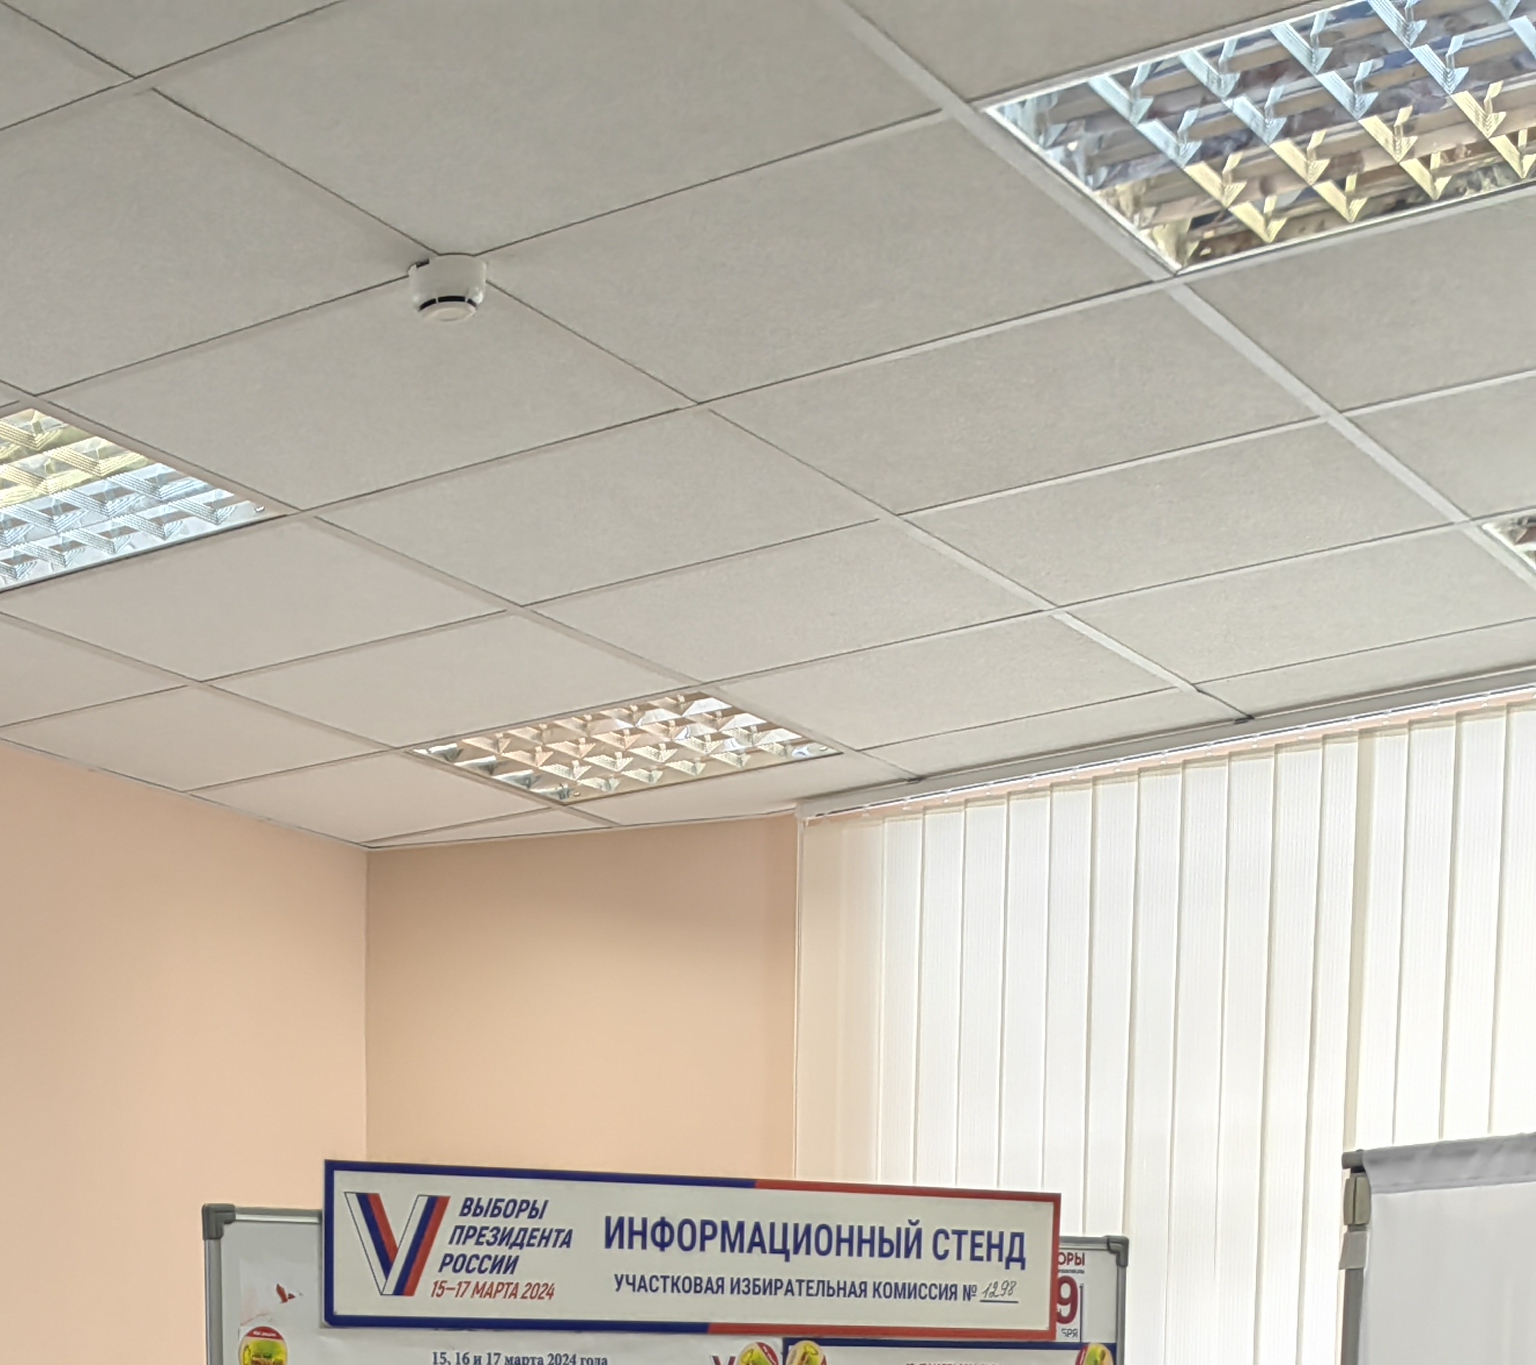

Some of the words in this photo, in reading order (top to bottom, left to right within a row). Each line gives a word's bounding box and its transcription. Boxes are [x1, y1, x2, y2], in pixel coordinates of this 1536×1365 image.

[458, 1197, 549, 1219] ВЫБОРЫ
[448, 1225, 574, 1250] ПРЕЗИДЕНТА
[604, 1215, 923, 1262] ИНФОРМАЦИОННЫЙ
[932, 1228, 1026, 1270] СТЕНД
[438, 1253, 520, 1275] РОССИИ
[471, 1281, 518, 1299] МАРТА
[520, 1282, 556, 1300] 2024
[614, 1274, 725, 1295] УЧАСТКОВАЯ
[730, 1277, 867, 1299] ИЗБИРАТЕЛЬНАЯ
[873, 1281, 958, 1301] КОМИССИЯ
[963, 1284, 977, 1301] №
[981, 1280, 1017, 1299] 1298
[456, 1352, 470, 1365] 16
[473, 1354, 482, 1365] и
[486, 1352, 501, 1365] 17
